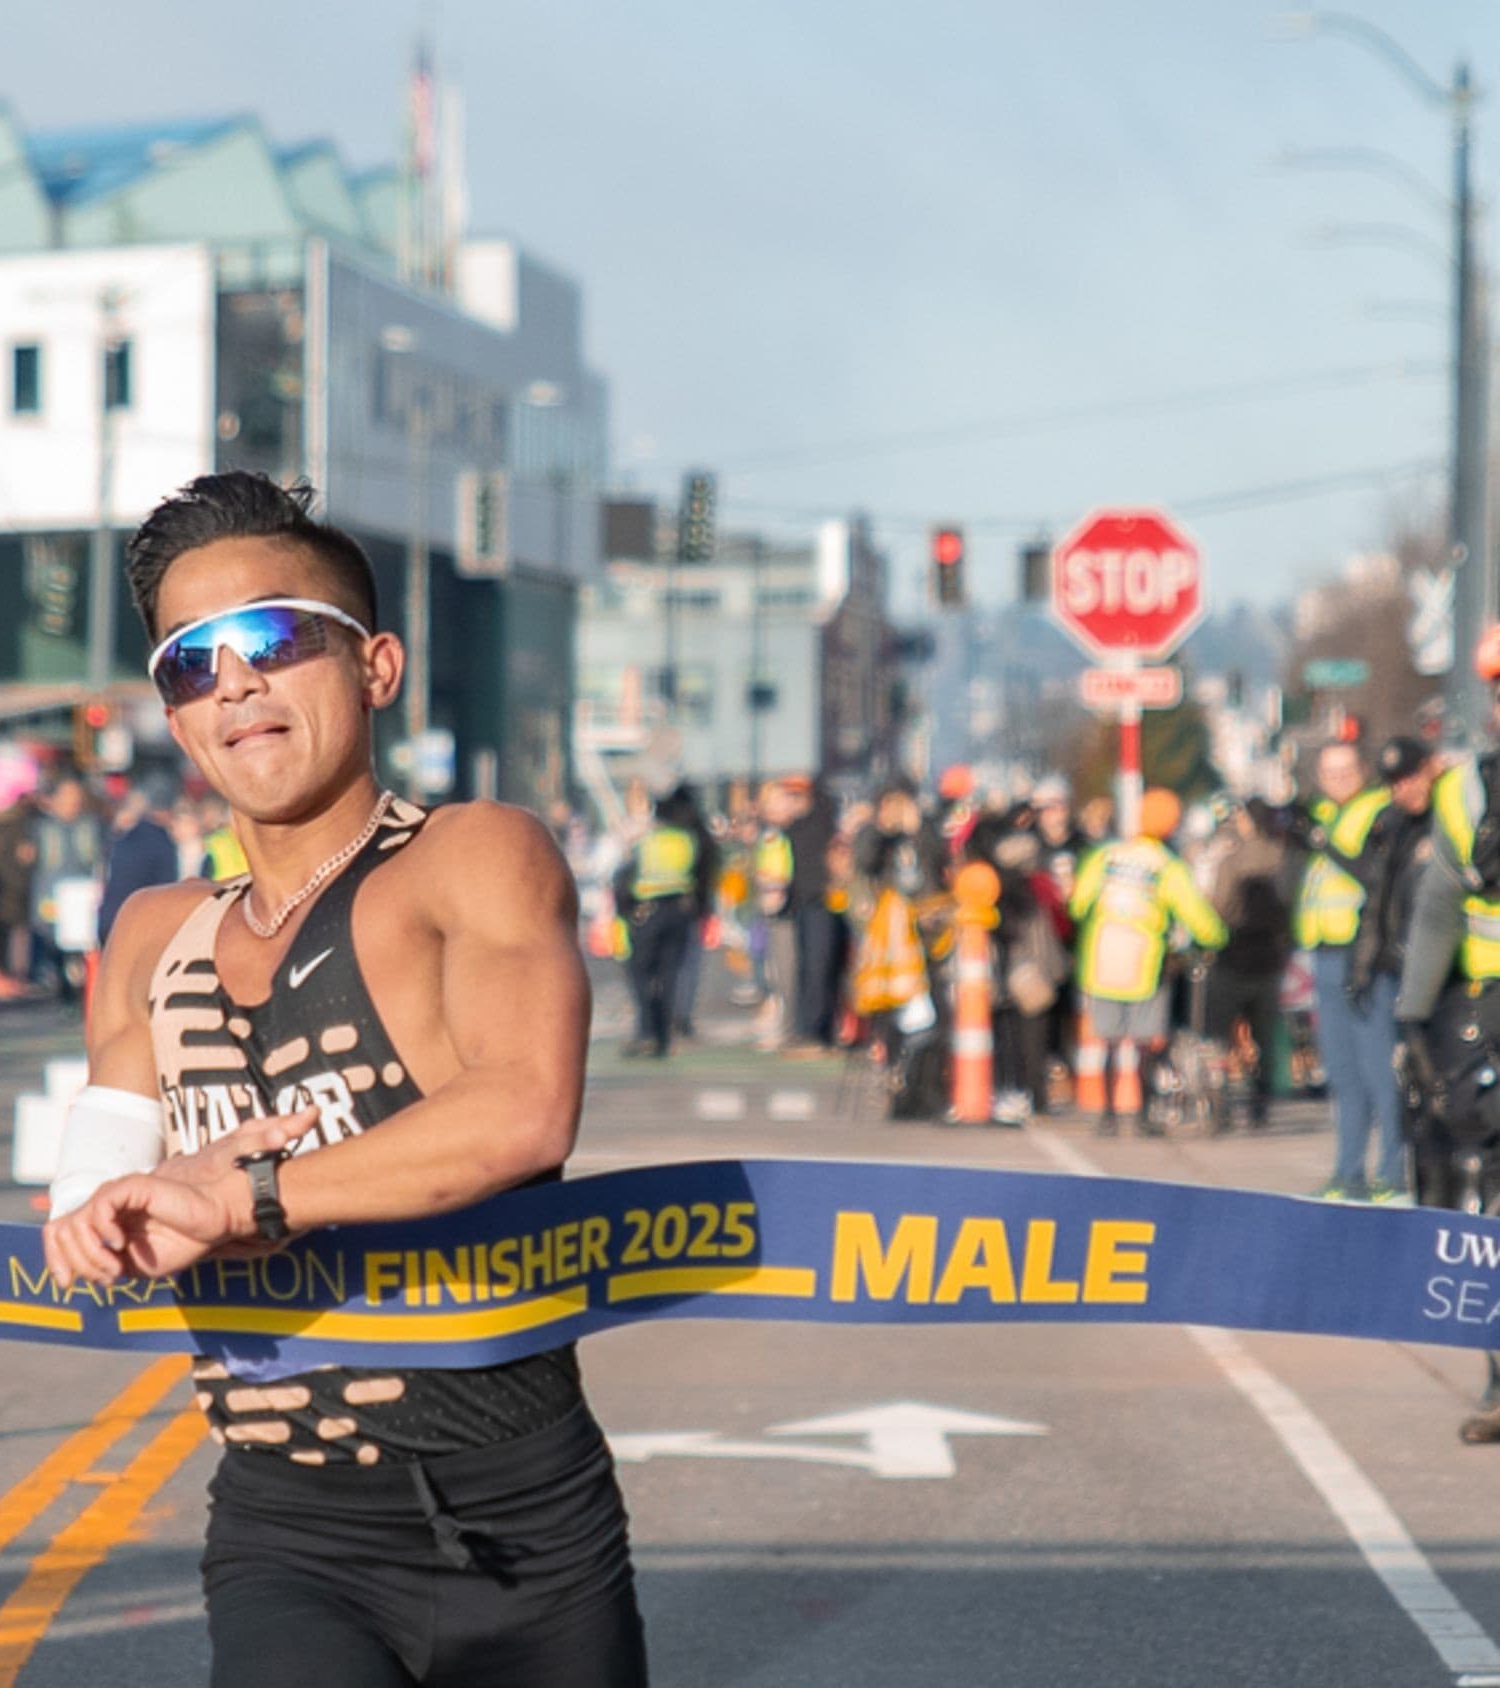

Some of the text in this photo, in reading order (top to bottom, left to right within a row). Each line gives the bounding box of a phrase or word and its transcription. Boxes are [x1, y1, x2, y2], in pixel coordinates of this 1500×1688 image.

[1064, 550, 1197, 616] STOP
[365, 1215, 609, 1306] FINISHER
[621, 1202, 756, 1264] 2025
[830, 1211, 1155, 1304] MALE
